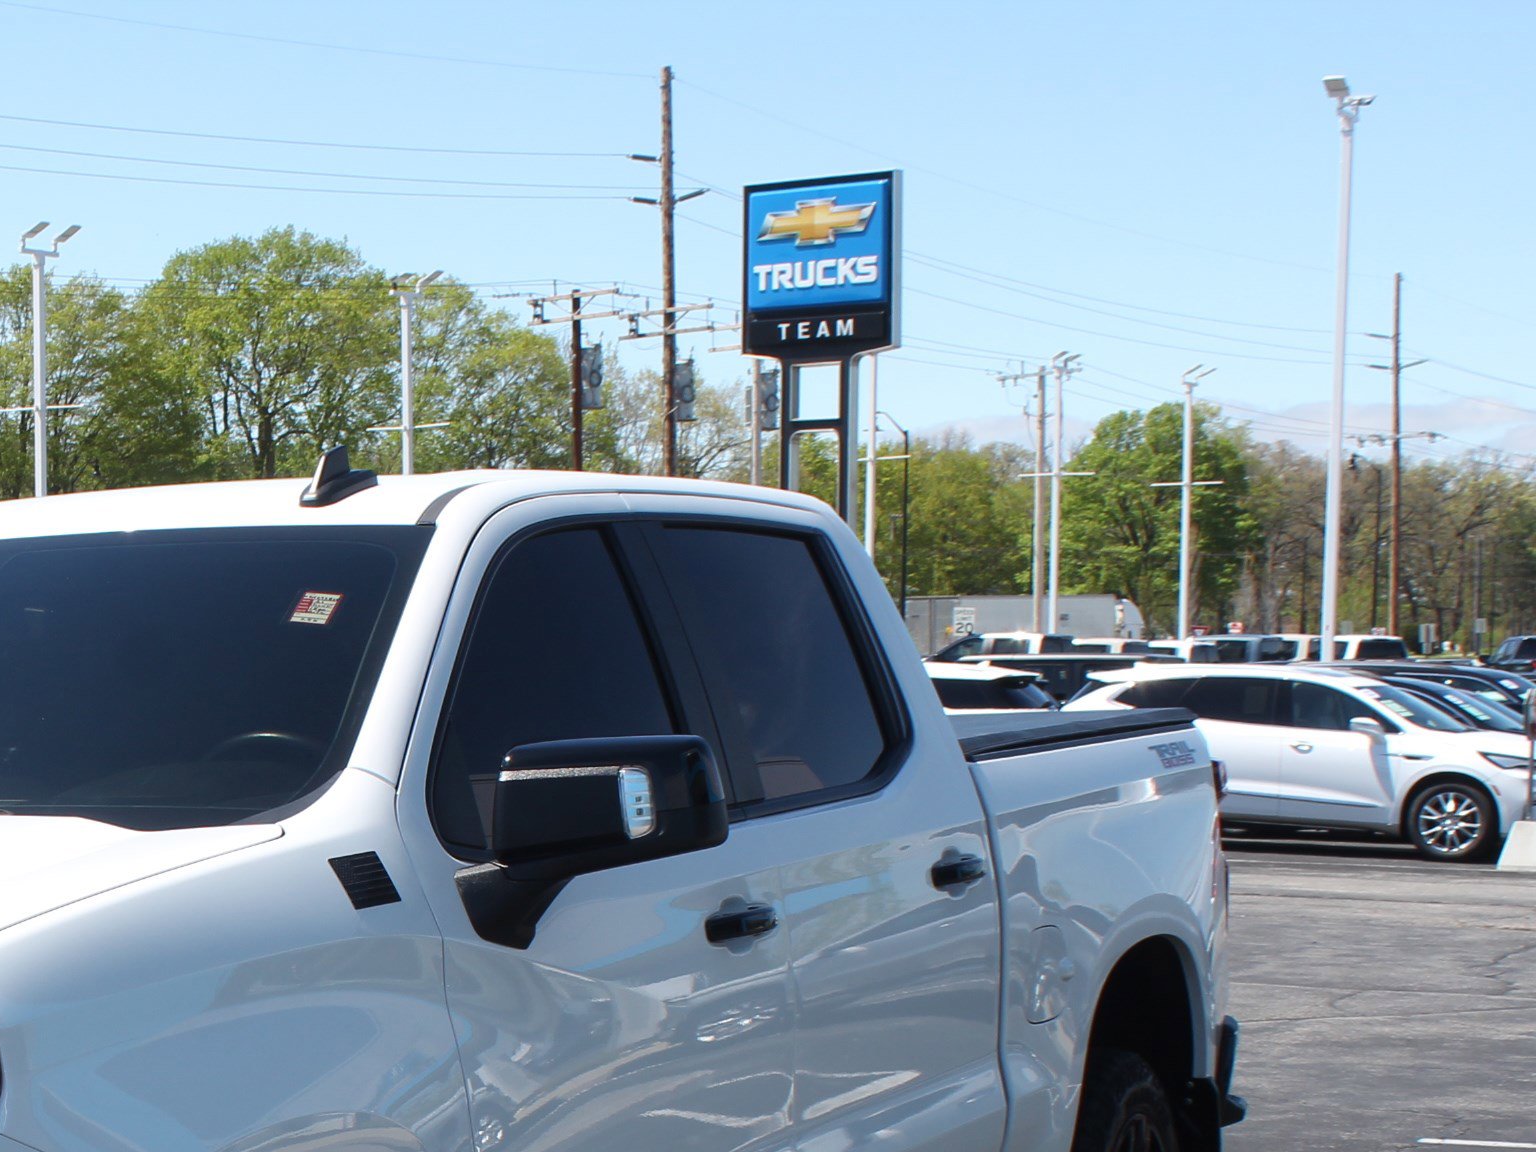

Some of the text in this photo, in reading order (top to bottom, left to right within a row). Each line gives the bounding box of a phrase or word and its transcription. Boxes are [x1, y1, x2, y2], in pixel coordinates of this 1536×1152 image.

[753, 255, 878, 292] TRUCKS
[777, 318, 855, 341] TEAM
[955, 622, 974, 634] 20
[1147, 740, 1196, 758] TRAIL
[1161, 755, 1196, 769] BOSS
